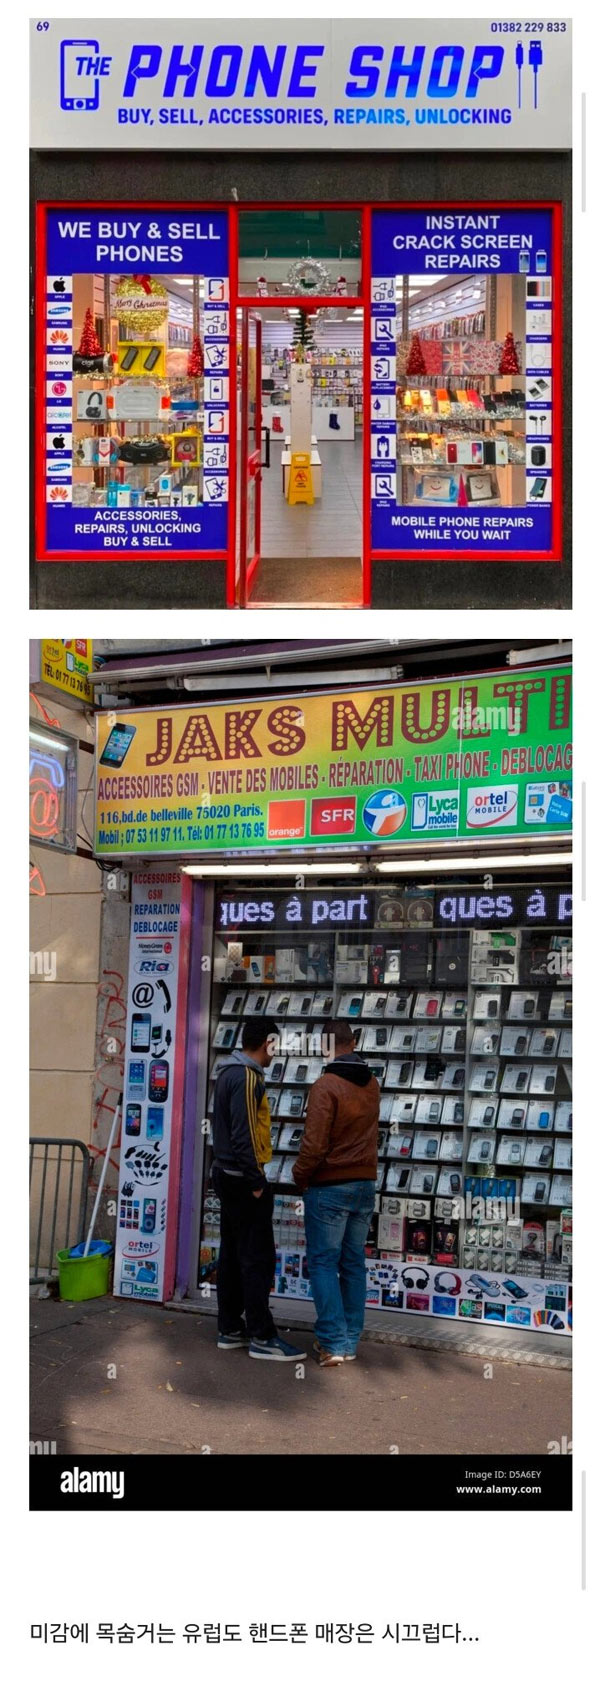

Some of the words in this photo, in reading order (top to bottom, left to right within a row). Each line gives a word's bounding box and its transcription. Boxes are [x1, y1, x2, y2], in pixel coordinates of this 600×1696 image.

[76, 56, 111, 76] THE
[123, 45, 324, 97] PHONE
[345, 46, 504, 98] SHOP
[118, 109, 154, 125] BUY,
[159, 109, 203, 125] SELL,
[208, 108, 328, 126] ACCESSORIES,
[334, 109, 410, 126] REPAIRS,
[416, 109, 511, 124] UNLOCKING
[168, 223, 220, 239] SELL
[393, 235, 455, 249] CRACK
[461, 235, 532, 248] SCREEN
[96, 246, 183, 262] PHONES
[392, 517, 436, 526] MOBILE
[440, 517, 480, 527] PHONE
[146, 706, 306, 767] JAKS
[98, 775, 173, 801] ACCEESSOIRES
[177, 773, 198, 796] GSM
[209, 769, 243, 795] VENTE
[269, 764, 318, 791] MOBILES
[329, 757, 403, 787] RÉPARATION
[415, 756, 441, 782] TAXI
[475, 792, 507, 806] ortel
[151, 808, 193, 821] belleville
[197, 806, 230, 819] 75020
[321, 809, 353, 822] SFR
[135, 904, 180, 915] REPARATION
[312, 895, 368, 924] part
[134, 921, 178, 932] DEBLOCAGE
